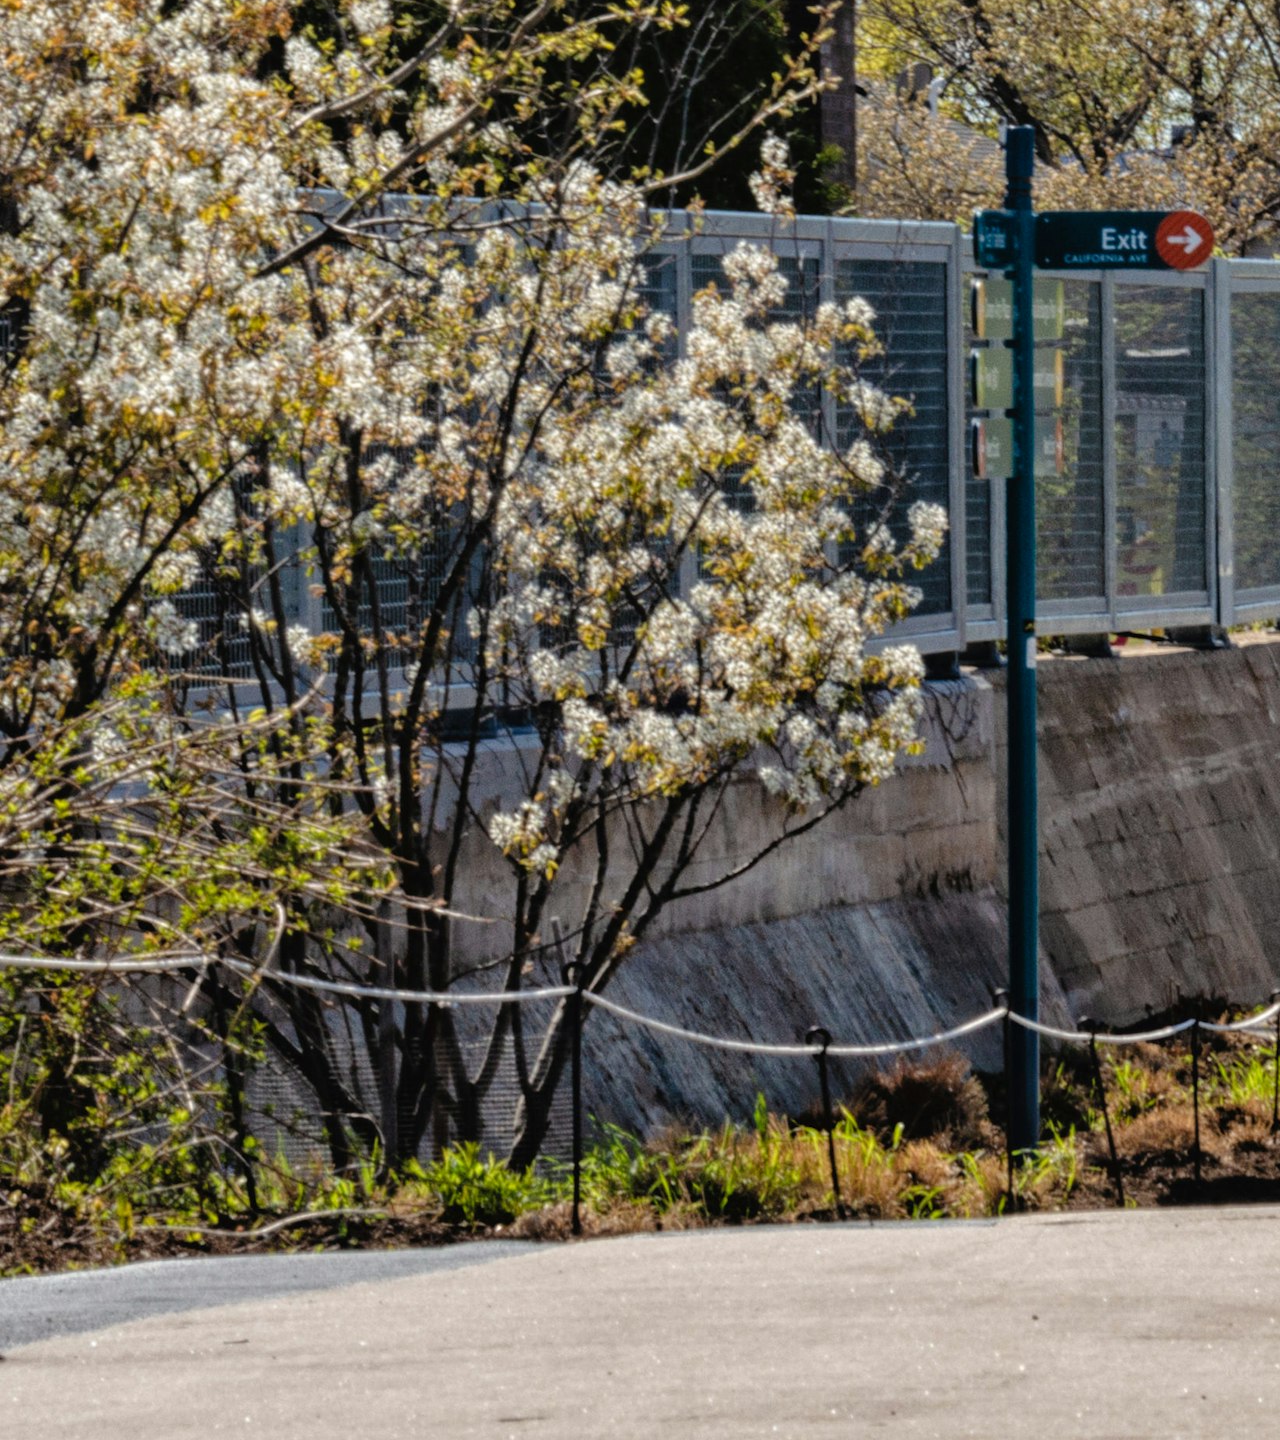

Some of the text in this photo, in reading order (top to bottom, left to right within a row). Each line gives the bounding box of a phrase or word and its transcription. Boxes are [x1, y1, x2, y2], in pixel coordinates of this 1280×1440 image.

[1101, 227, 1148, 250] Exit
[1064, 253, 1147, 263] CALIFORNIA AVE
